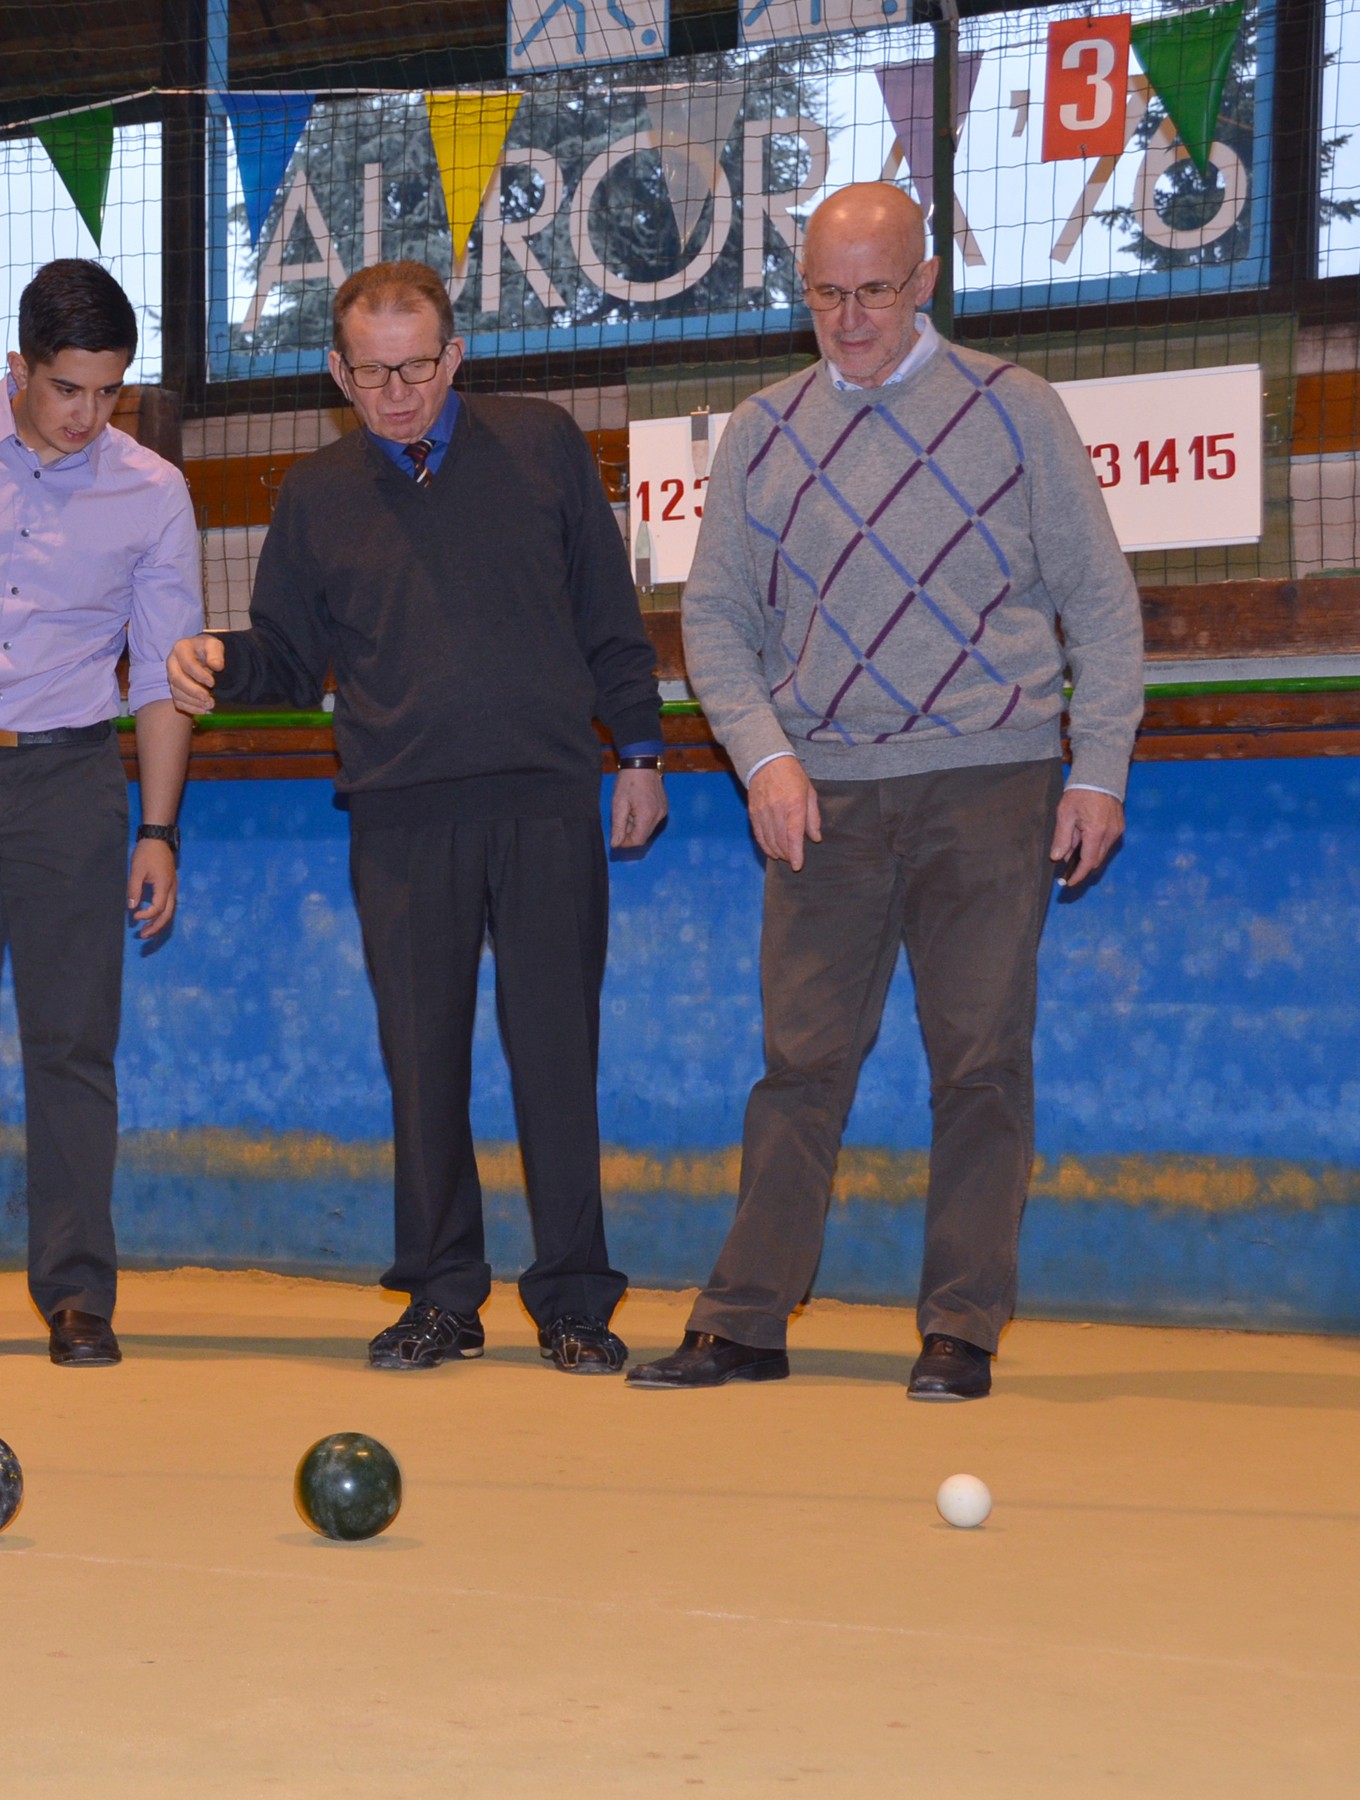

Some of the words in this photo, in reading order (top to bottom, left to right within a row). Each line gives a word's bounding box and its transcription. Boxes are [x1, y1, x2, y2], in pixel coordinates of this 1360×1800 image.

[1059, 38, 1116, 131] 3
[1084, 443, 1121, 489] 3
[1133, 437, 1179, 486] 14
[1188, 432, 1236, 481] 15
